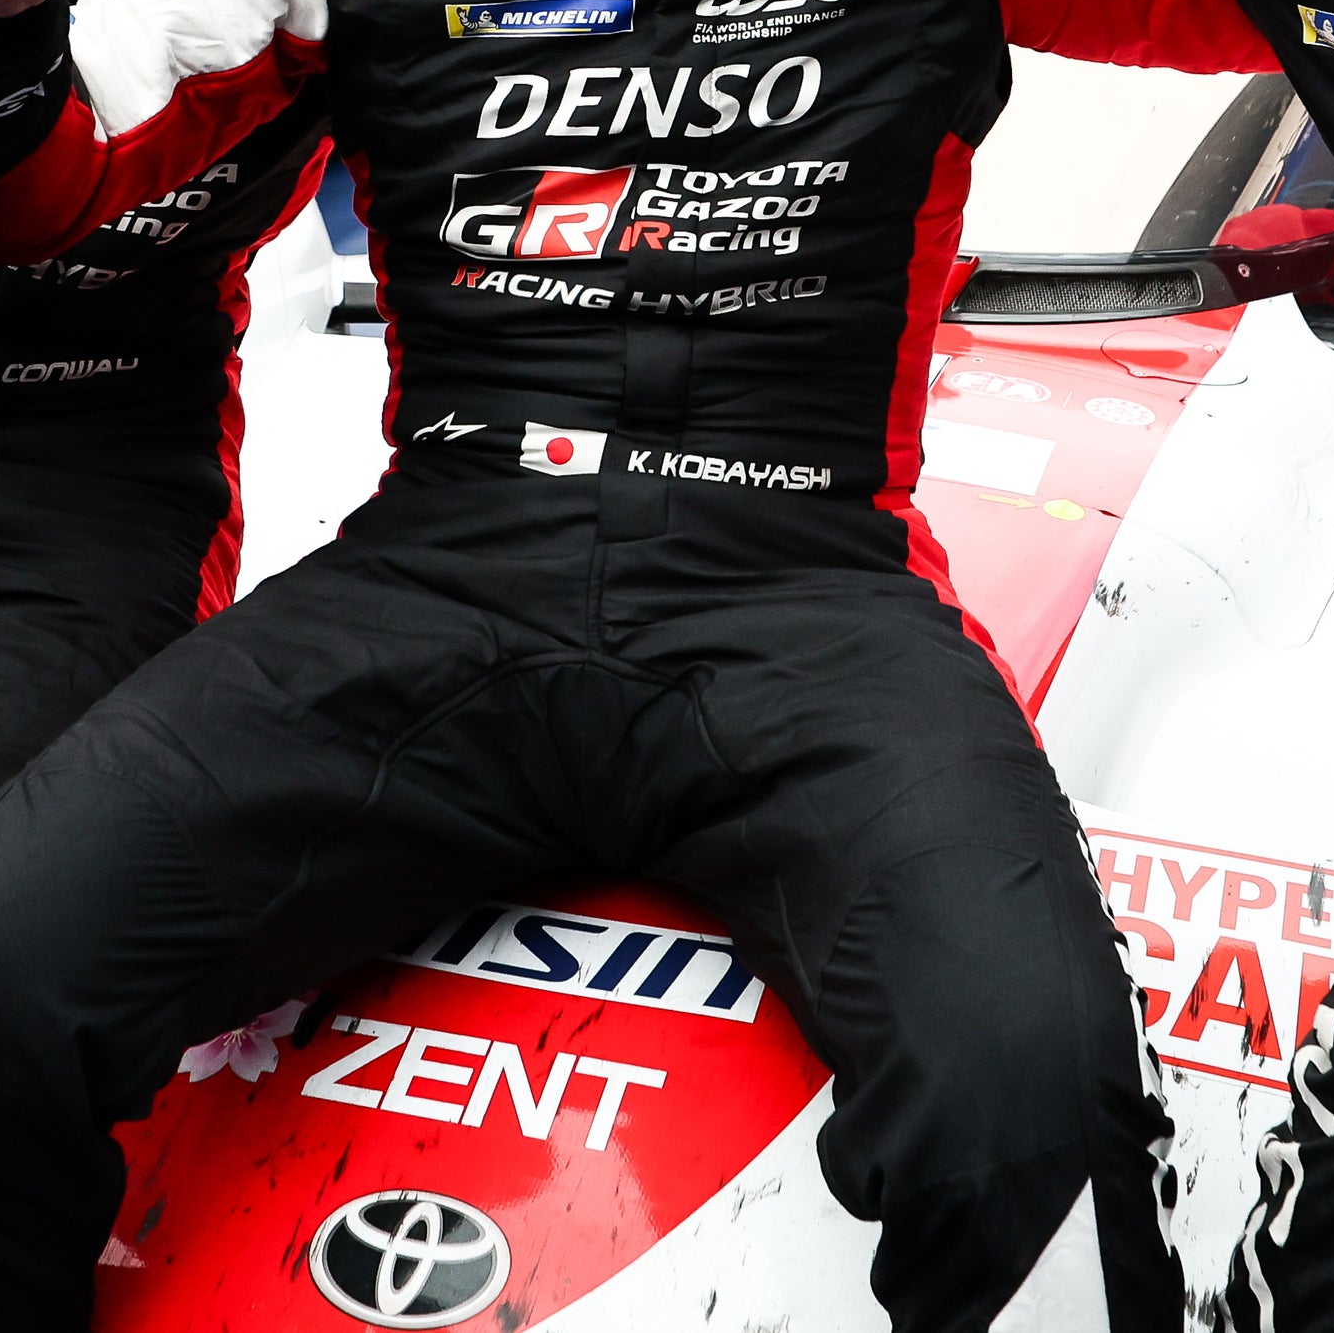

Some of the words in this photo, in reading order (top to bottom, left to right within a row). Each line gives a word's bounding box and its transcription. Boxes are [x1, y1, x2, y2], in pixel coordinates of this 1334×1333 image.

[501, 7, 618, 26] MICHELIN
[693, 25, 793, 44] CHAMPIONSHIP
[695, 22, 717, 35] FIA
[718, 19, 765, 35] WORLD
[767, 8, 846, 29] ENDURANCE
[476, 55, 822, 139] DENSO
[647, 160, 850, 193] TOYOTA
[633, 190, 821, 220] GAZOO
[443, 202, 611, 256] GR
[619, 219, 799, 256] Racing
[451, 264, 615, 310] RACING
[627, 274, 827, 316] HYBRID
[628, 449, 655, 474] K.
[661, 452, 831, 491] KOBAYASHI
[395, 906, 759, 1011] ISIN
[301, 1015, 667, 1152] ZENT
